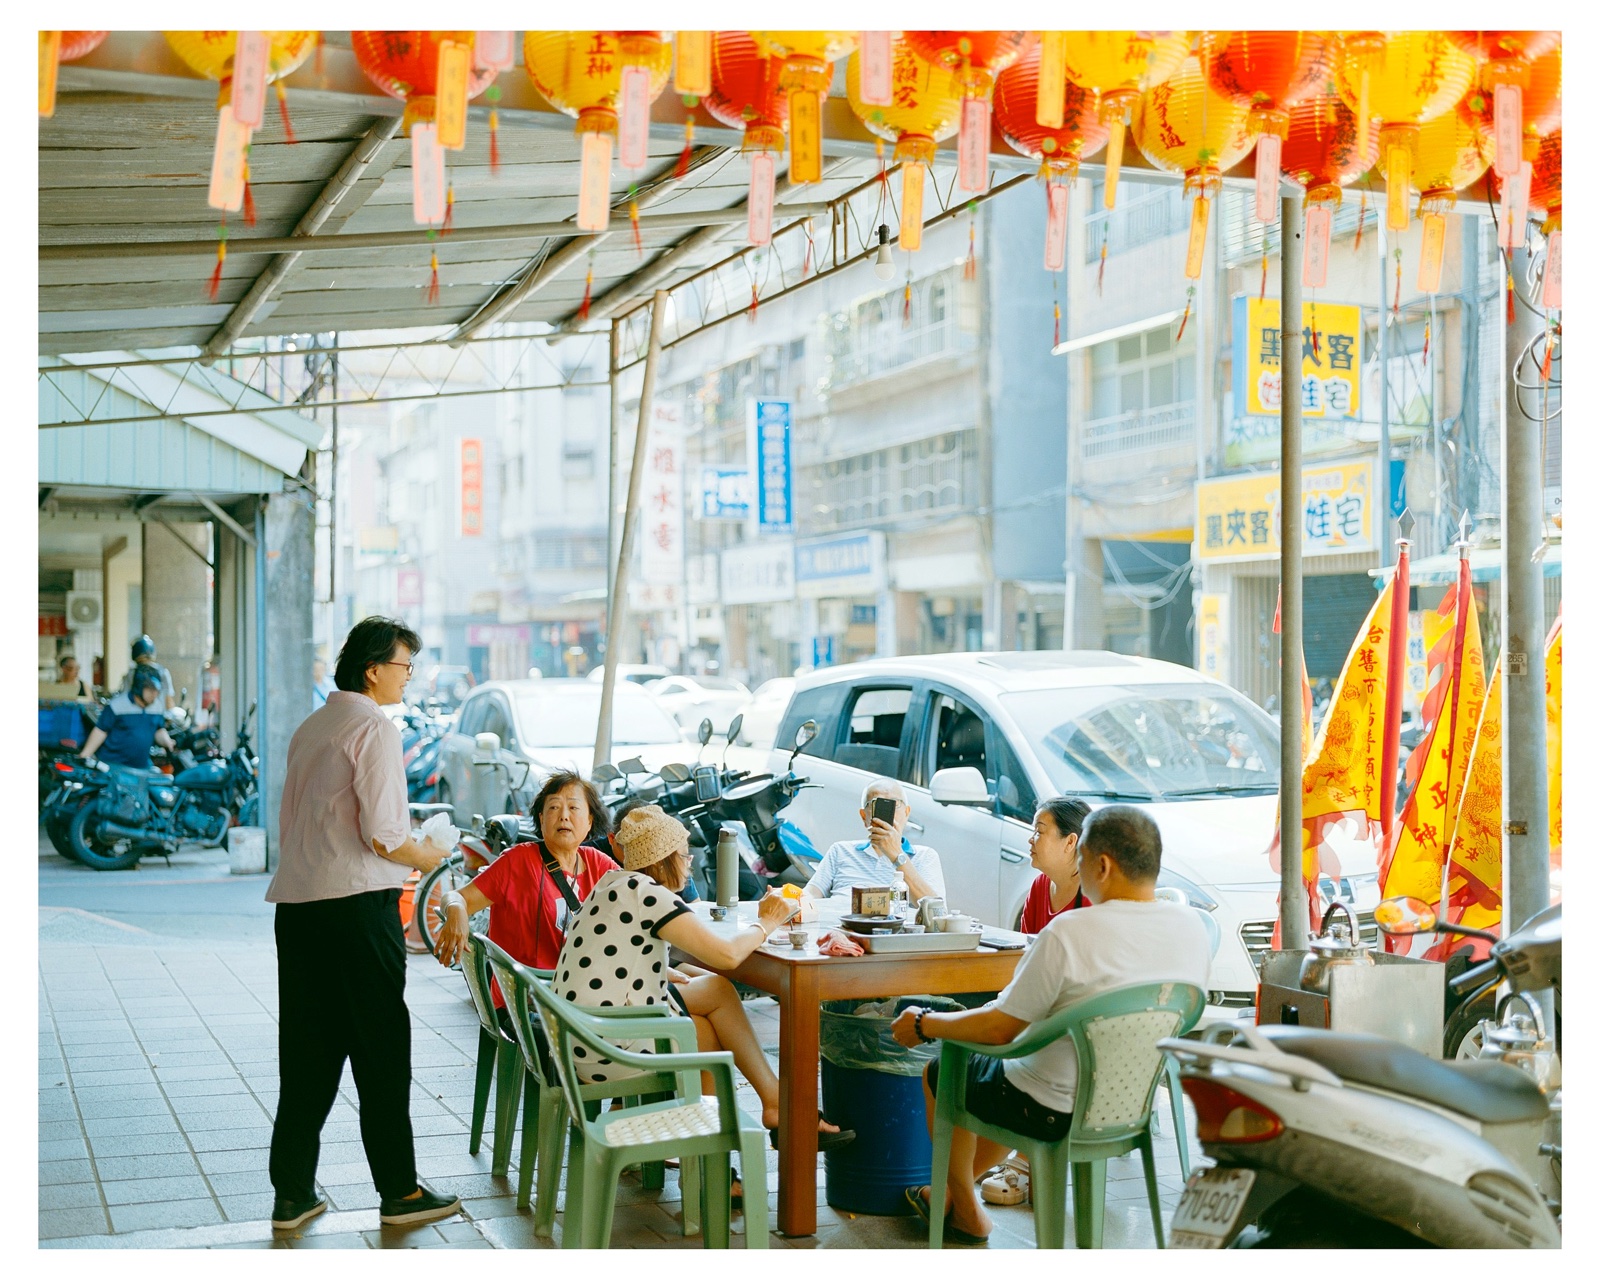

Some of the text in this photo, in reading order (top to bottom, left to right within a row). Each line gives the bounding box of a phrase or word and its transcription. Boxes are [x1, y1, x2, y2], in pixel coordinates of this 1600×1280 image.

[585, 33, 614, 79] 正神
[1206, 508, 1269, 549] 黑夾客
[865, 895, 887, 909] 普洱
